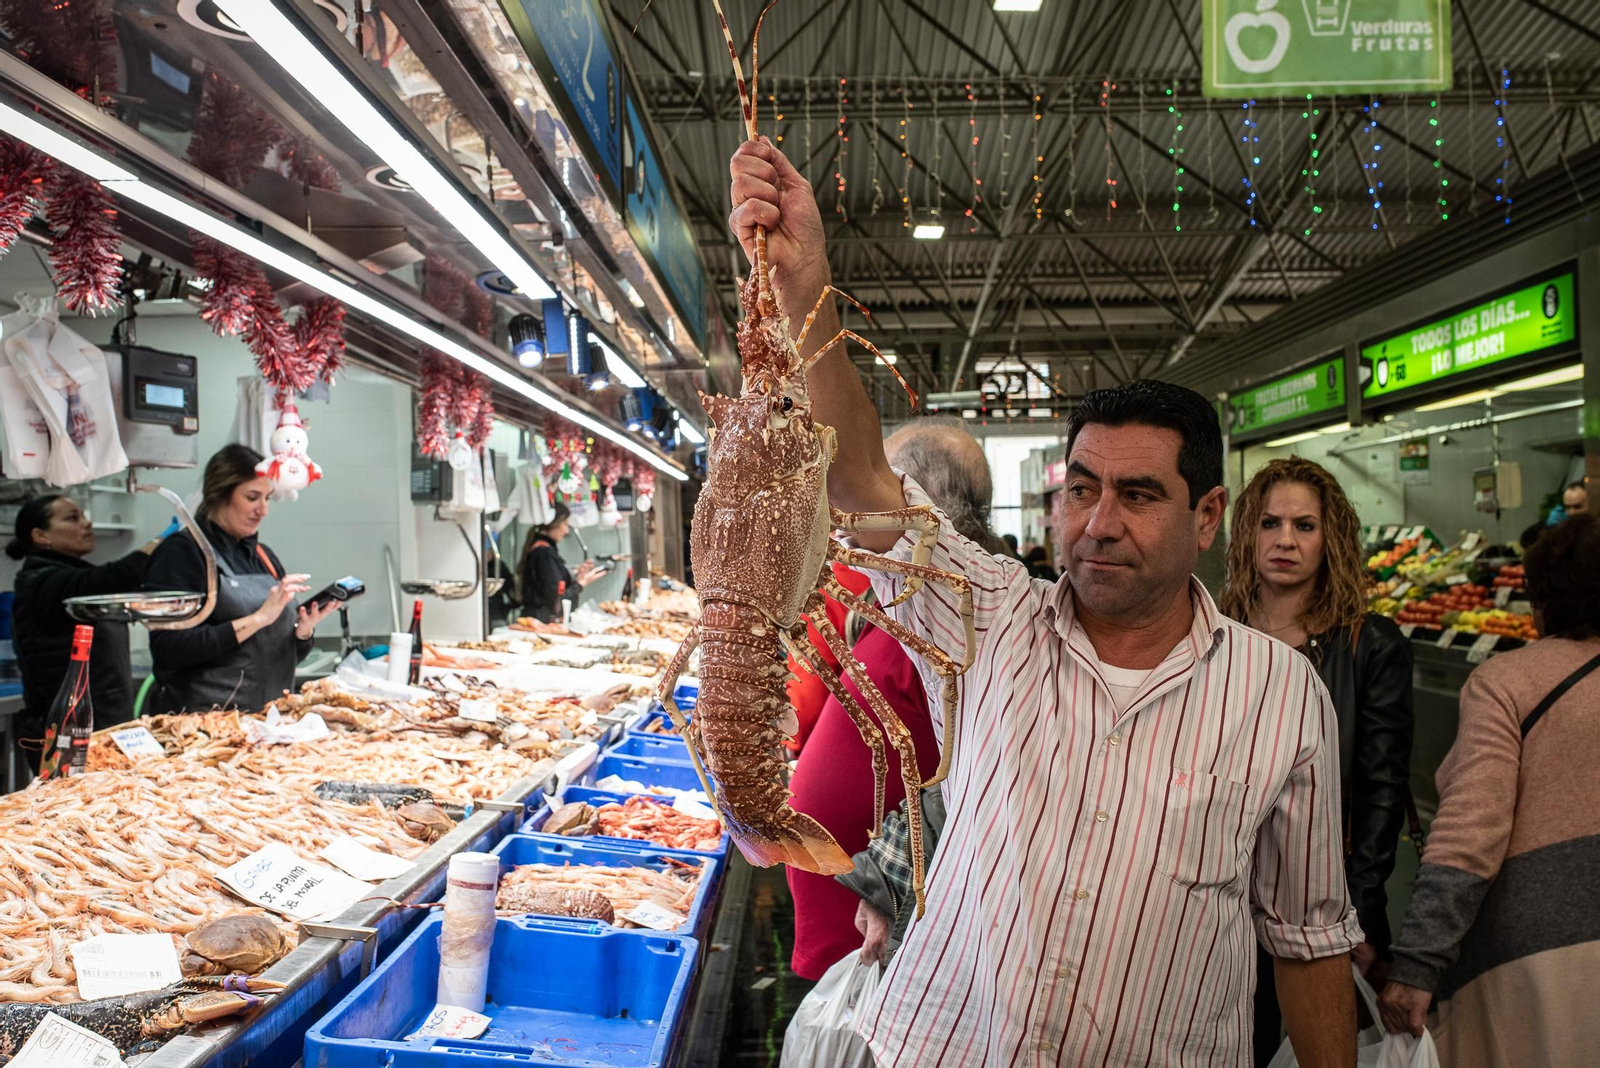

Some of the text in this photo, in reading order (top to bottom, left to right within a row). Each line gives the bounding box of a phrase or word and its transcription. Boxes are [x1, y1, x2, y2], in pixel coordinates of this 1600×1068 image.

[1351, 19, 1433, 37] Verduras
[1351, 37, 1433, 52] Frutas
[1411, 323, 1452, 355] TODOS
[1454, 313, 1478, 341] LOS
[1480, 299, 1531, 333] DÍAS...
[1431, 331, 1505, 375] ¡LO MEJOR!
[259, 891, 276, 903] DE
[294, 877, 325, 899] MORAL
